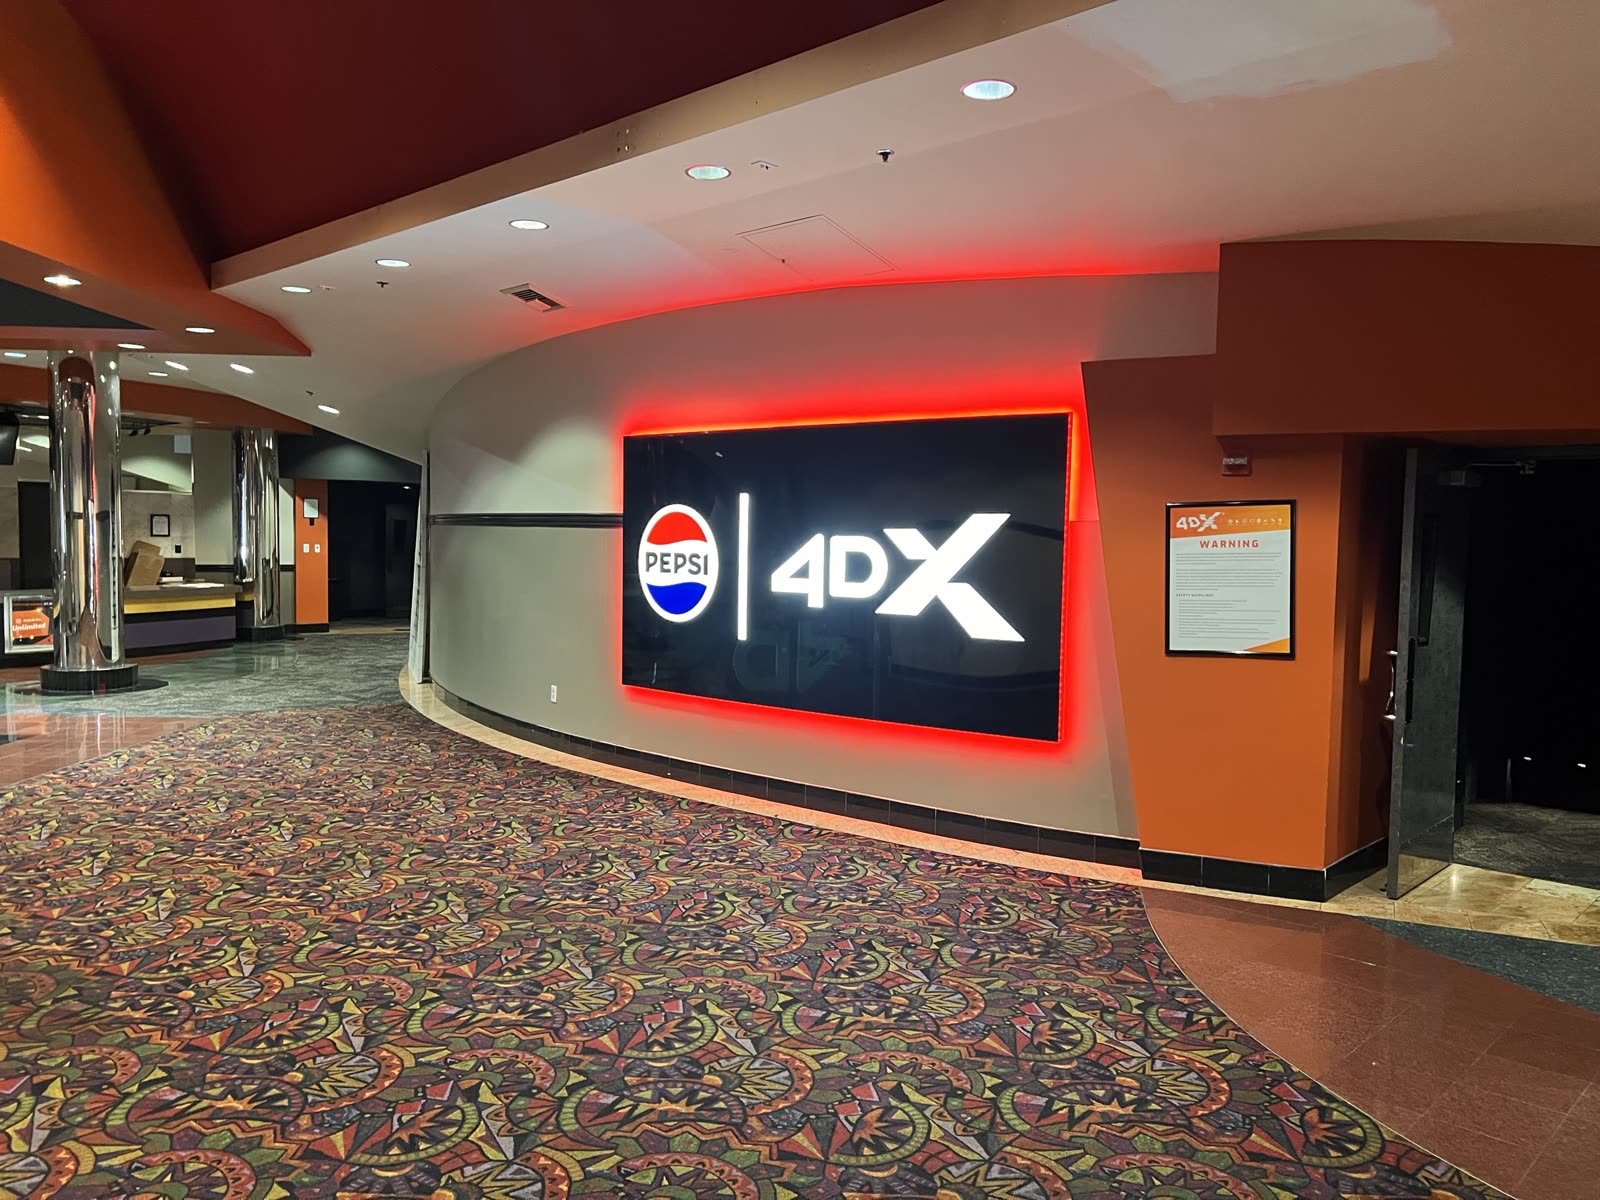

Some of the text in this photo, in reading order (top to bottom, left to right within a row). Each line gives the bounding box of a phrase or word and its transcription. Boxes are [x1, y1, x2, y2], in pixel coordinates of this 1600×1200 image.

[1176, 511, 1221, 532] 4DX
[1200, 540, 1259, 548] WARNING
[645, 551, 709, 576] PEPSI
[771, 513, 1025, 642] 4DX
[13, 623, 46, 631] Unlimited
